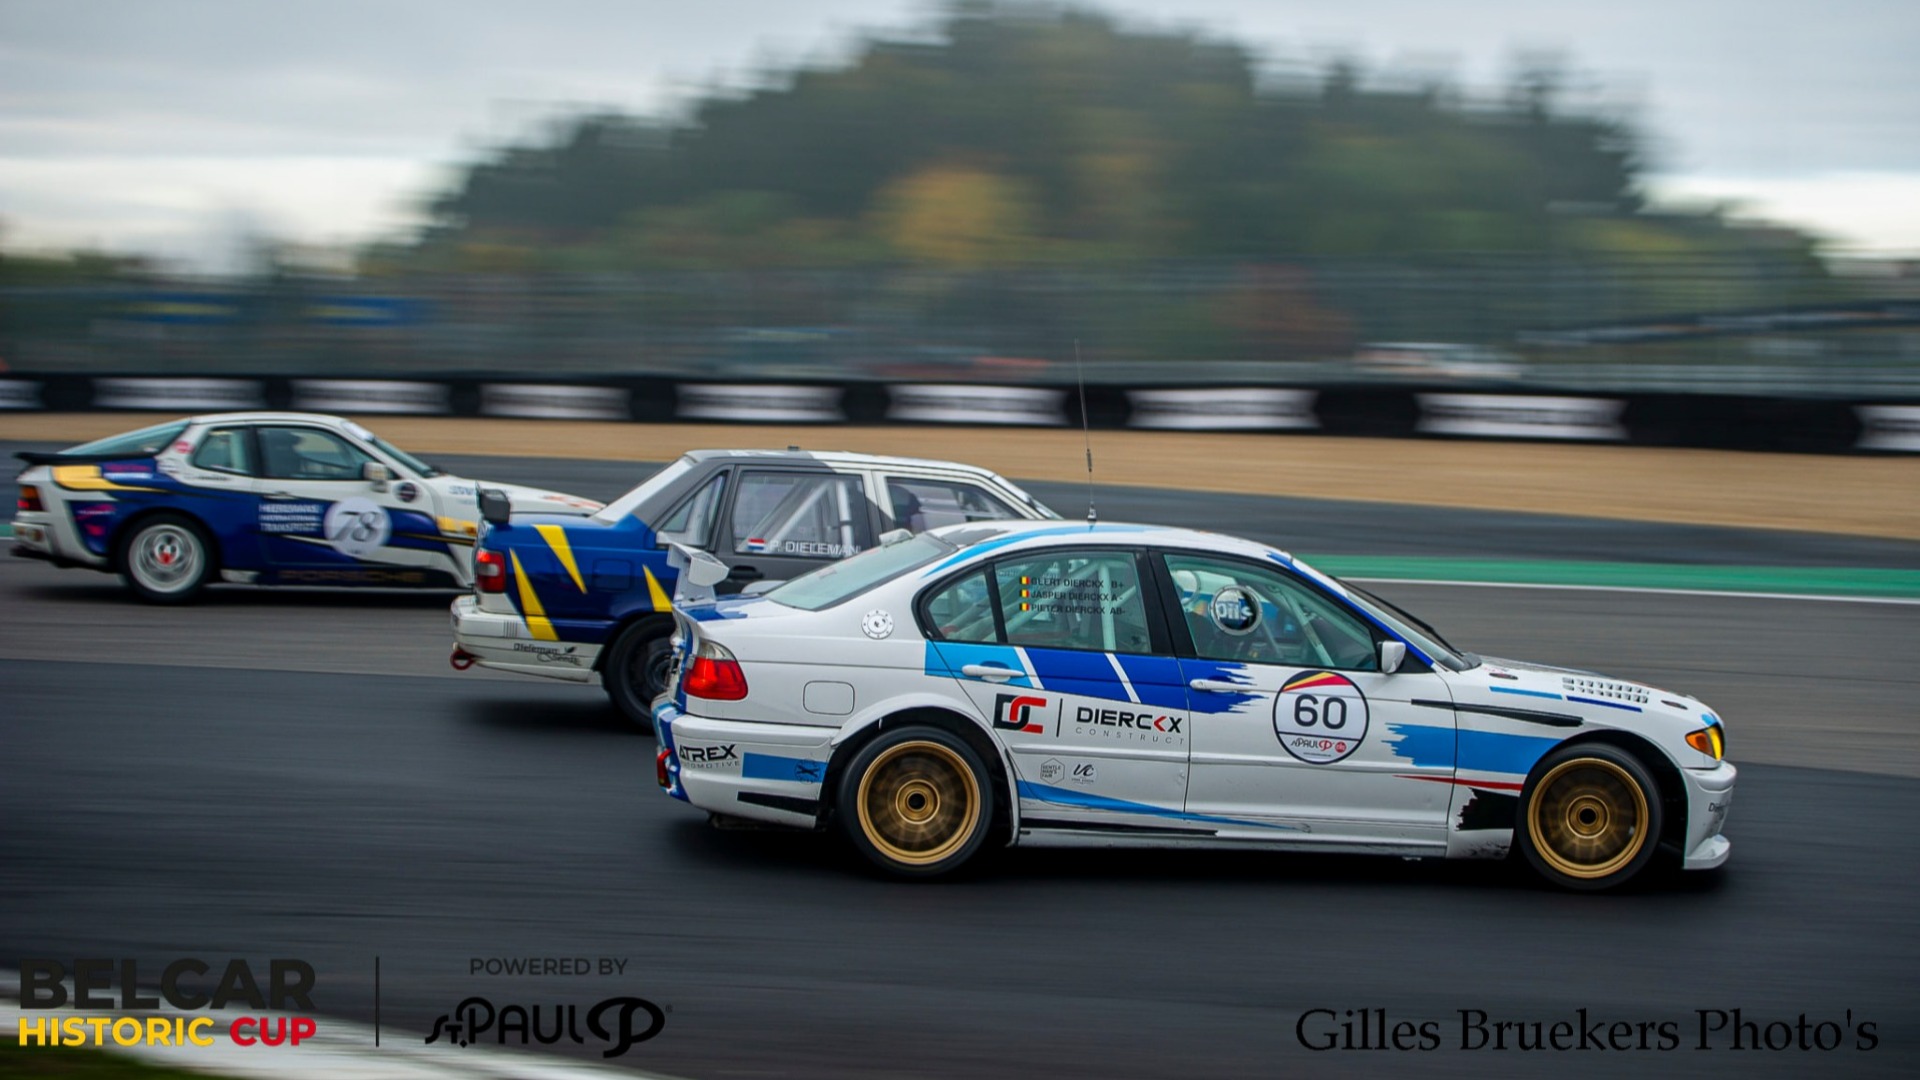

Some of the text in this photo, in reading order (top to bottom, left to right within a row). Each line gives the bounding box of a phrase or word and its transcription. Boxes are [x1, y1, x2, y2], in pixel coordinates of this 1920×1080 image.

[332, 510, 382, 542] 78
[785, 541, 860, 557] DIELEMAN
[1064, 579, 1104, 588] DIERCKX
[1069, 592, 1109, 602] DIERCKX
[1066, 605, 1105, 614] DIERCKX
[1294, 694, 1347, 730] 60
[1075, 727, 1184, 746] CONSTRUCT
[679, 743, 738, 762] ATREX
